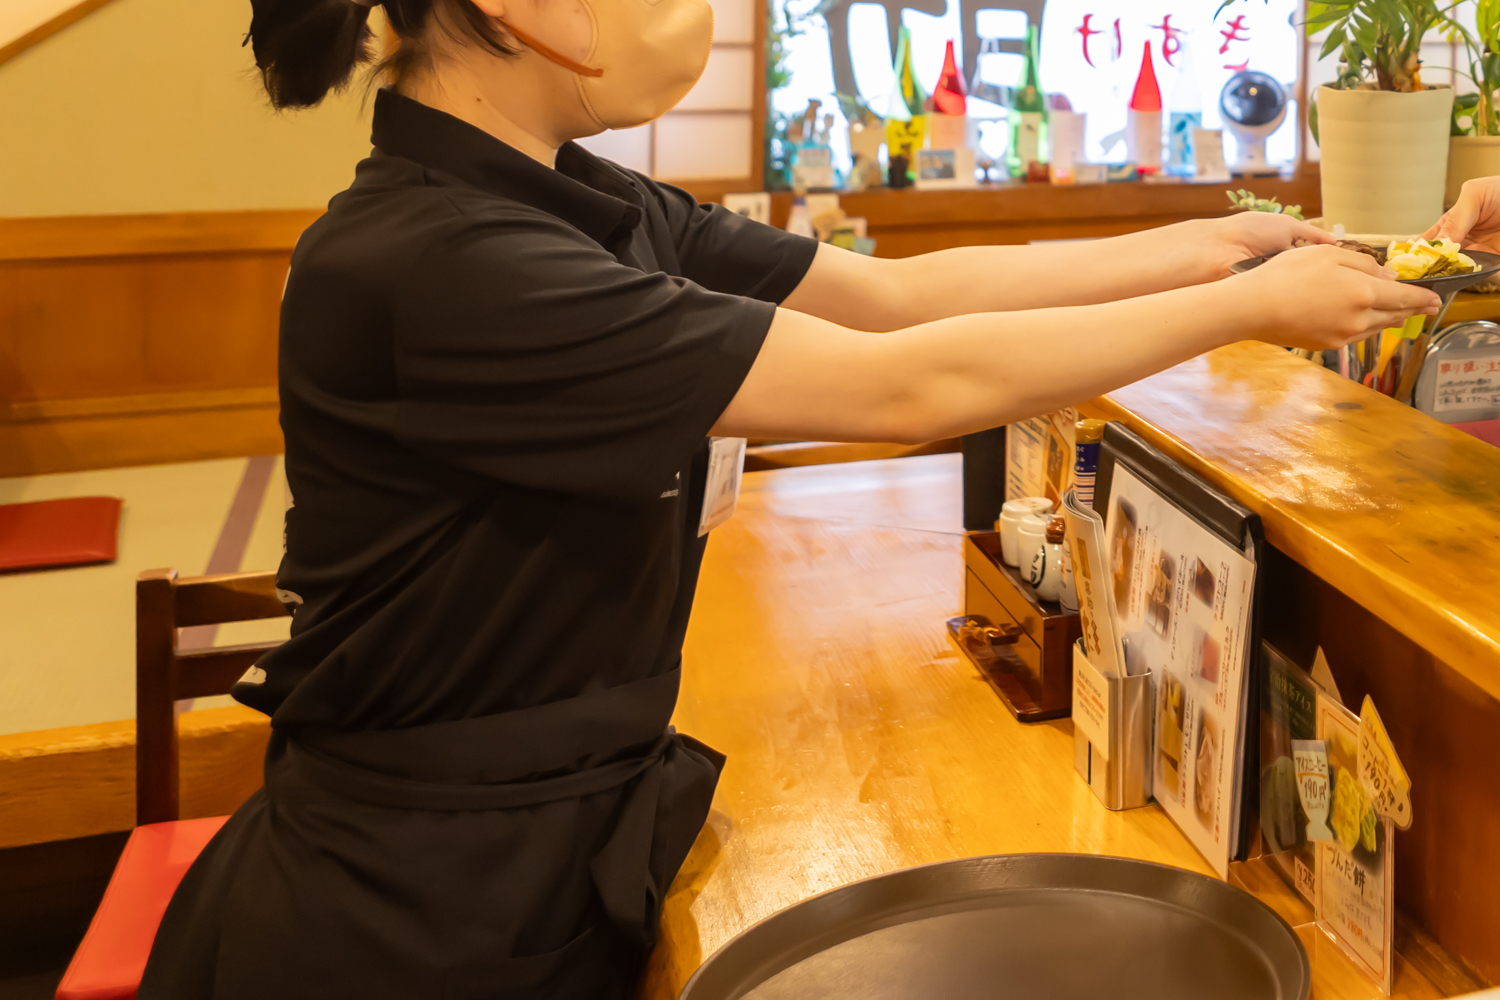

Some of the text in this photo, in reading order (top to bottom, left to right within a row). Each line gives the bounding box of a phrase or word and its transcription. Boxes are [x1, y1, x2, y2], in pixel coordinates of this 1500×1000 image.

[1296, 756, 1326, 773] アイスコーヒー
[1304, 778, 1327, 801] 190円
